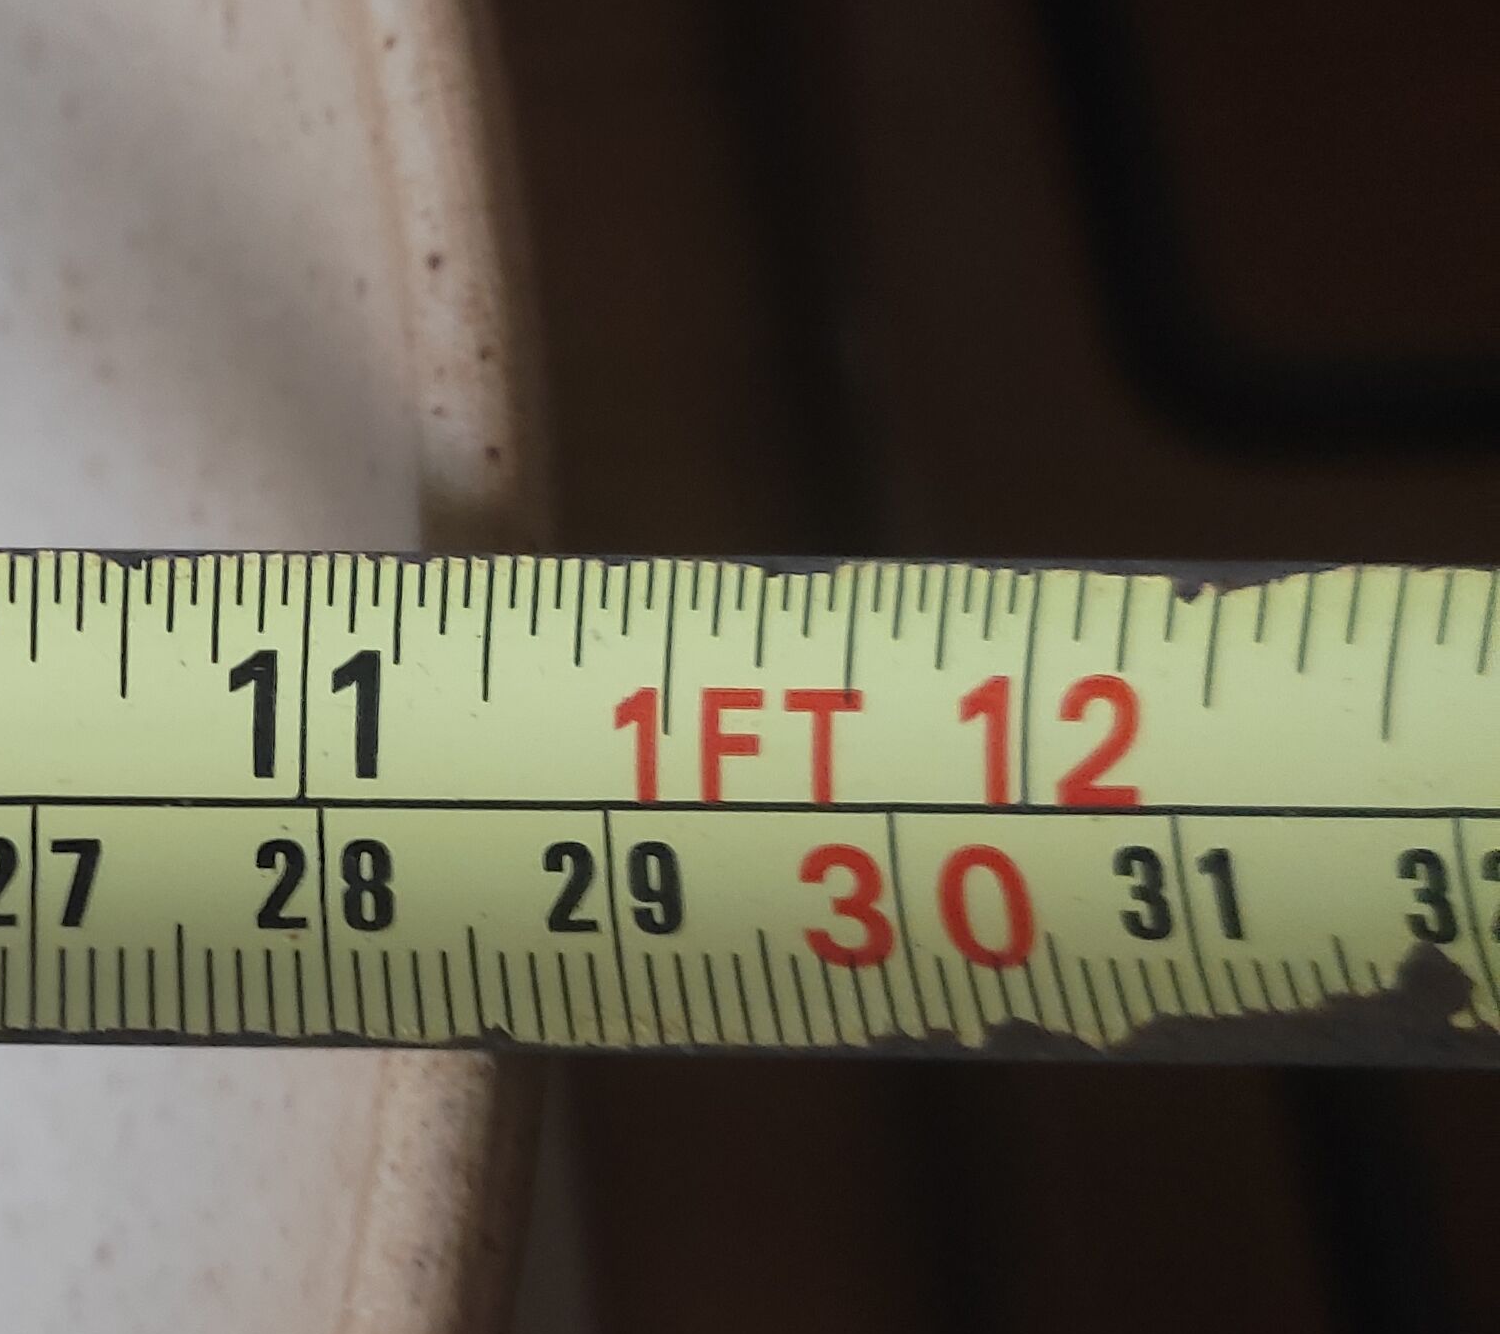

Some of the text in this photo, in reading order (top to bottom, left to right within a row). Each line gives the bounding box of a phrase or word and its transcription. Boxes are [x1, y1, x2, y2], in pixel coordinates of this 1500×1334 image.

[228, 649, 382, 779] 11
[958, 673, 1144, 808] 12
[254, 838, 395, 932] 28
[542, 841, 685, 934] 29
[798, 843, 1037, 969] 30
[1111, 846, 1246, 942] 31
